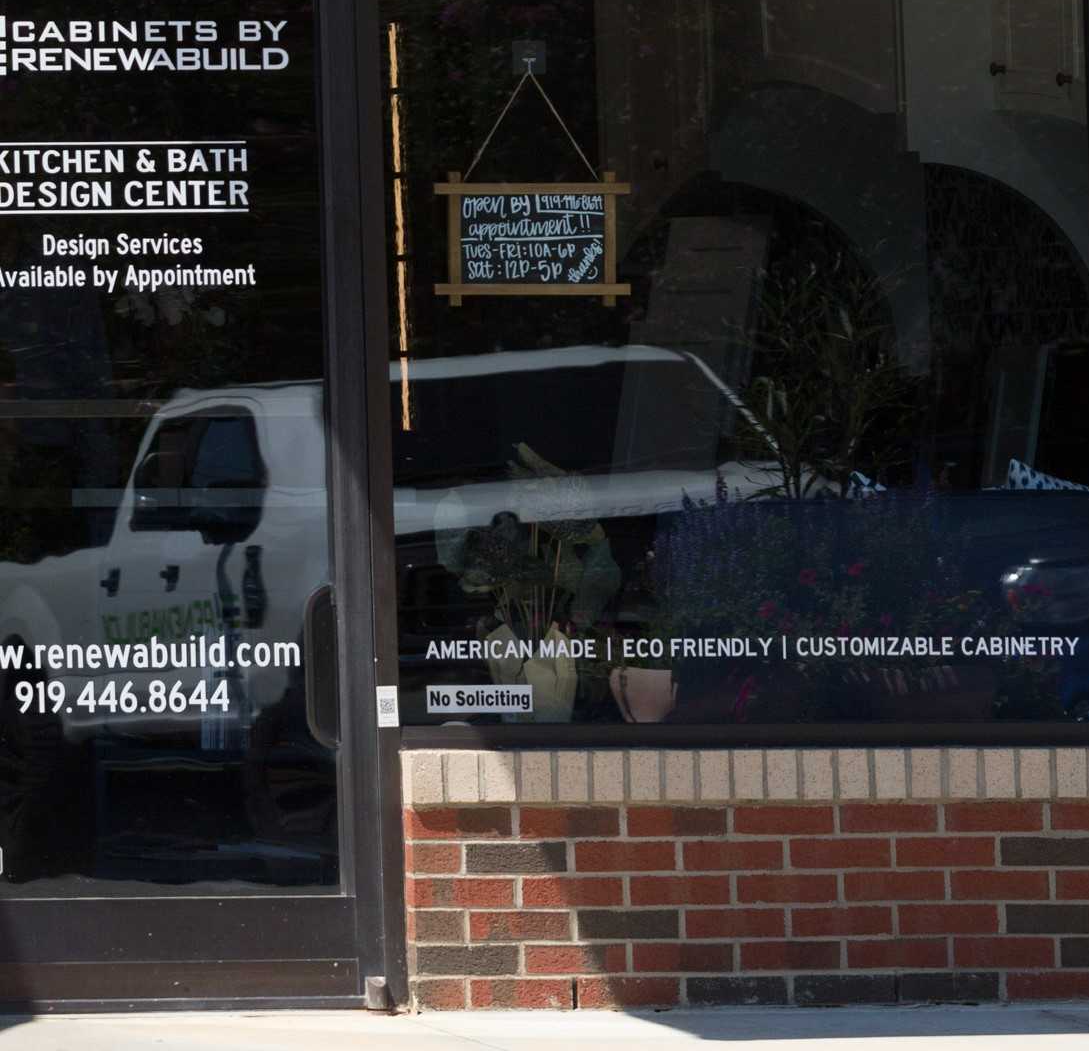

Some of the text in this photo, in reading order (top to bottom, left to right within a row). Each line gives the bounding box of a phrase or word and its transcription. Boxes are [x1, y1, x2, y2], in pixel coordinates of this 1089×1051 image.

[12, 20, 288, 43] CABINETS BY
[12, 47, 289, 72] RENEWABUILD
[135, 148, 156, 173] &
[167, 148, 248, 173] BATH
[0, 180, 249, 208] DESIGN CENTER
[42, 232, 203, 260] Design Services
[92, 264, 119, 294] by
[124, 263, 257, 293] Appointment
[425, 639, 533, 660] AMERICAN
[539, 638, 597, 659] MADE
[623, 638, 664, 658] ECO
[670, 637, 774, 658] FRIENDLY
[796, 636, 954, 657] CUSTOMIZABLE
[961, 636, 1080, 656] CABINETRY
[15, 679, 230, 714] 919.446.8644
[430, 690, 531, 711] No Soliciting
